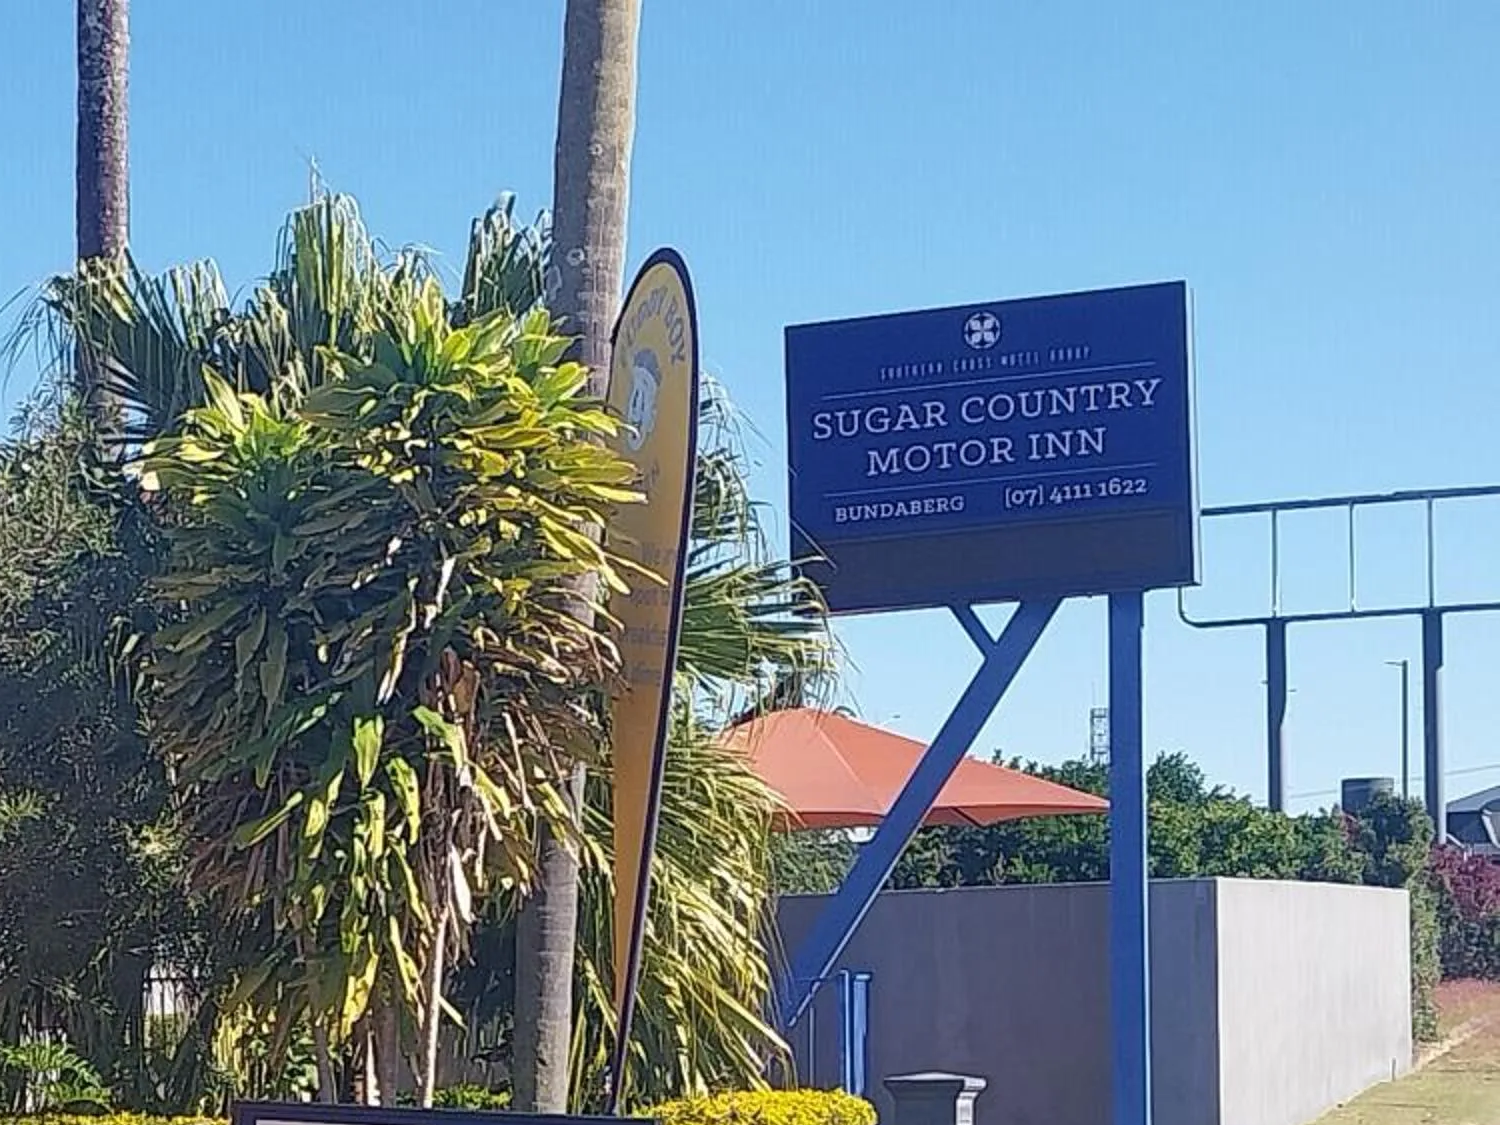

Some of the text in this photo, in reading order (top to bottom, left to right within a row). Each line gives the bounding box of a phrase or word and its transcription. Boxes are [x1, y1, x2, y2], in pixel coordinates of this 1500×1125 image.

[812, 378, 1163, 439] SUGAR COUNTRY
[866, 427, 1107, 477] MOTOR INN
[835, 496, 966, 523] BUNDABERG
[1049, 483, 1093, 506] 4111
[1098, 477, 1149, 498] 1622
